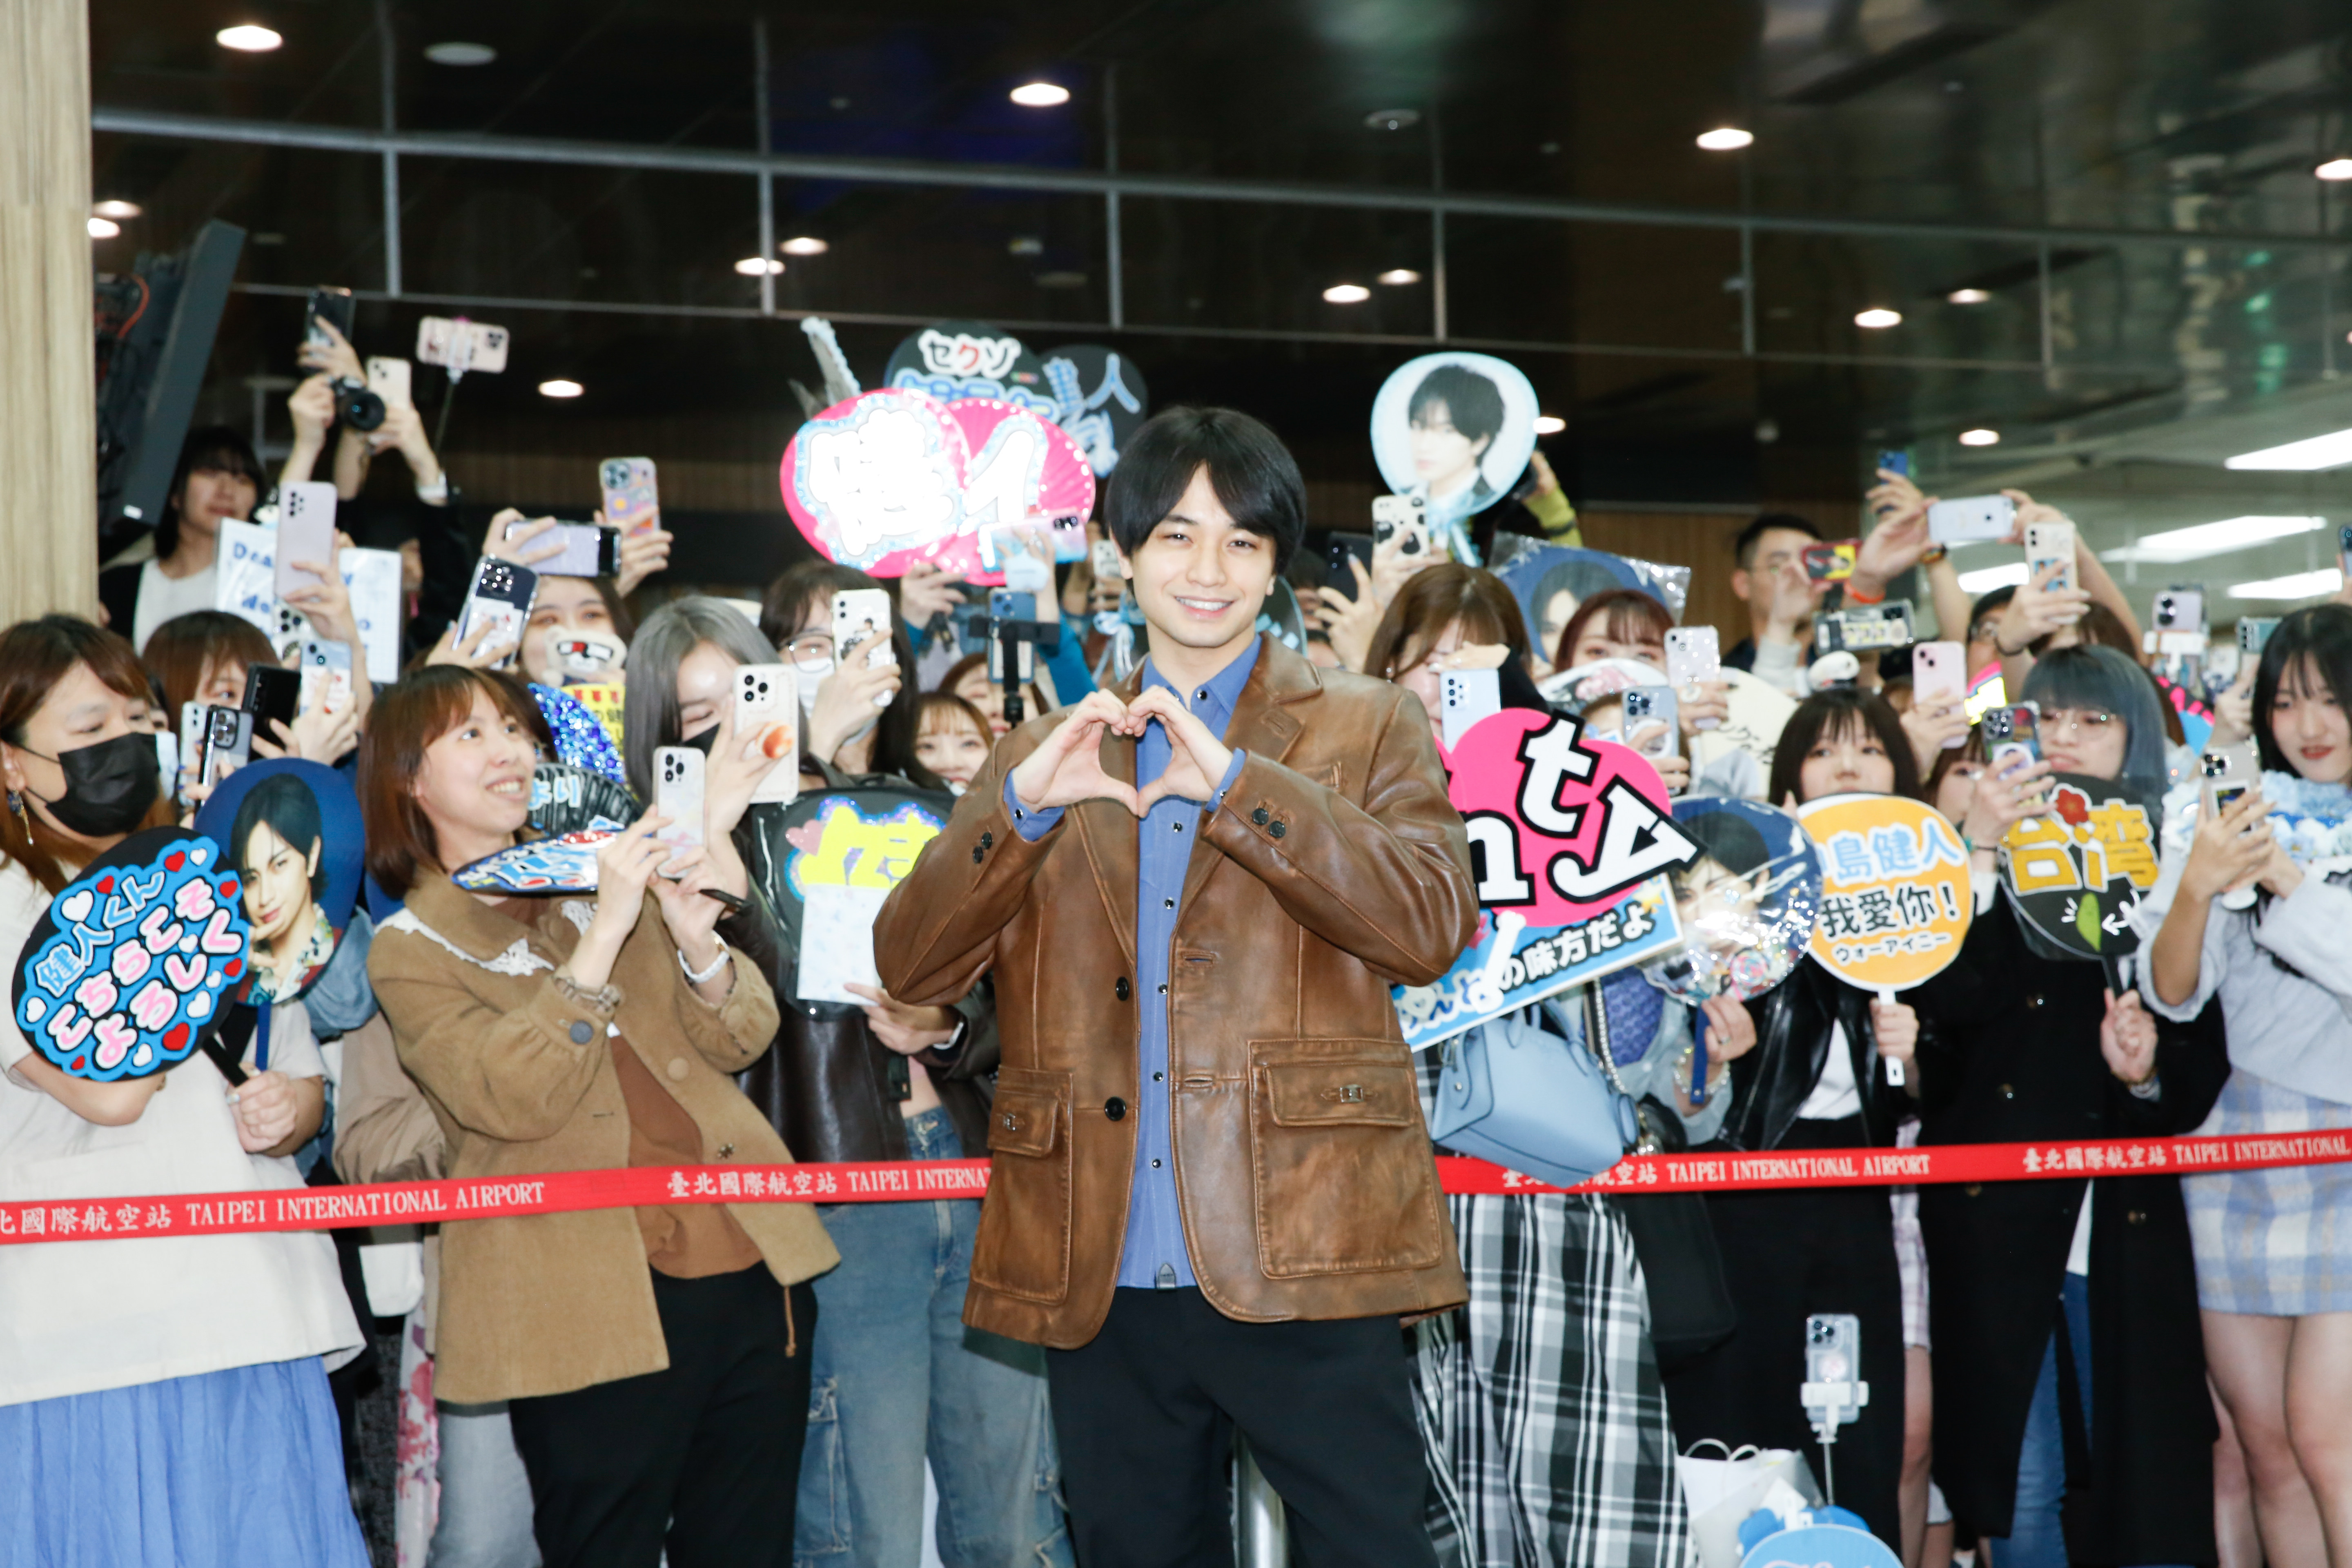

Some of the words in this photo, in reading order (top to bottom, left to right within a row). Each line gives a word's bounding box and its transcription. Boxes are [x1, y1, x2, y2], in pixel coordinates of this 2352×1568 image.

[1817, 820, 1961, 883] 島健人
[34, 871, 167, 998] 健人くん
[47, 878, 216, 1051] こちらこそ
[94, 909, 243, 1069] よろしく
[1666, 1160, 1726, 1183] TAIPEI
[1732, 1156, 1858, 1181] INTERNATIONAL
[1863, 1154, 1931, 1177] AIRPORT
[2022, 1145, 2167, 1173] 臺北國際航空站
[2172, 1143, 2229, 1165] TAIPEI
[2234, 1135, 2351, 1162] INTERNATIONAL
[667, 1170, 838, 1198] 臺北國際航空站
[846, 1169, 910, 1193] TAIPEI
[185, 1199, 267, 1227] TAIPEI
[276, 1189, 448, 1222] INTERNATIONAL
[455, 1181, 546, 1210] AIRPORT
